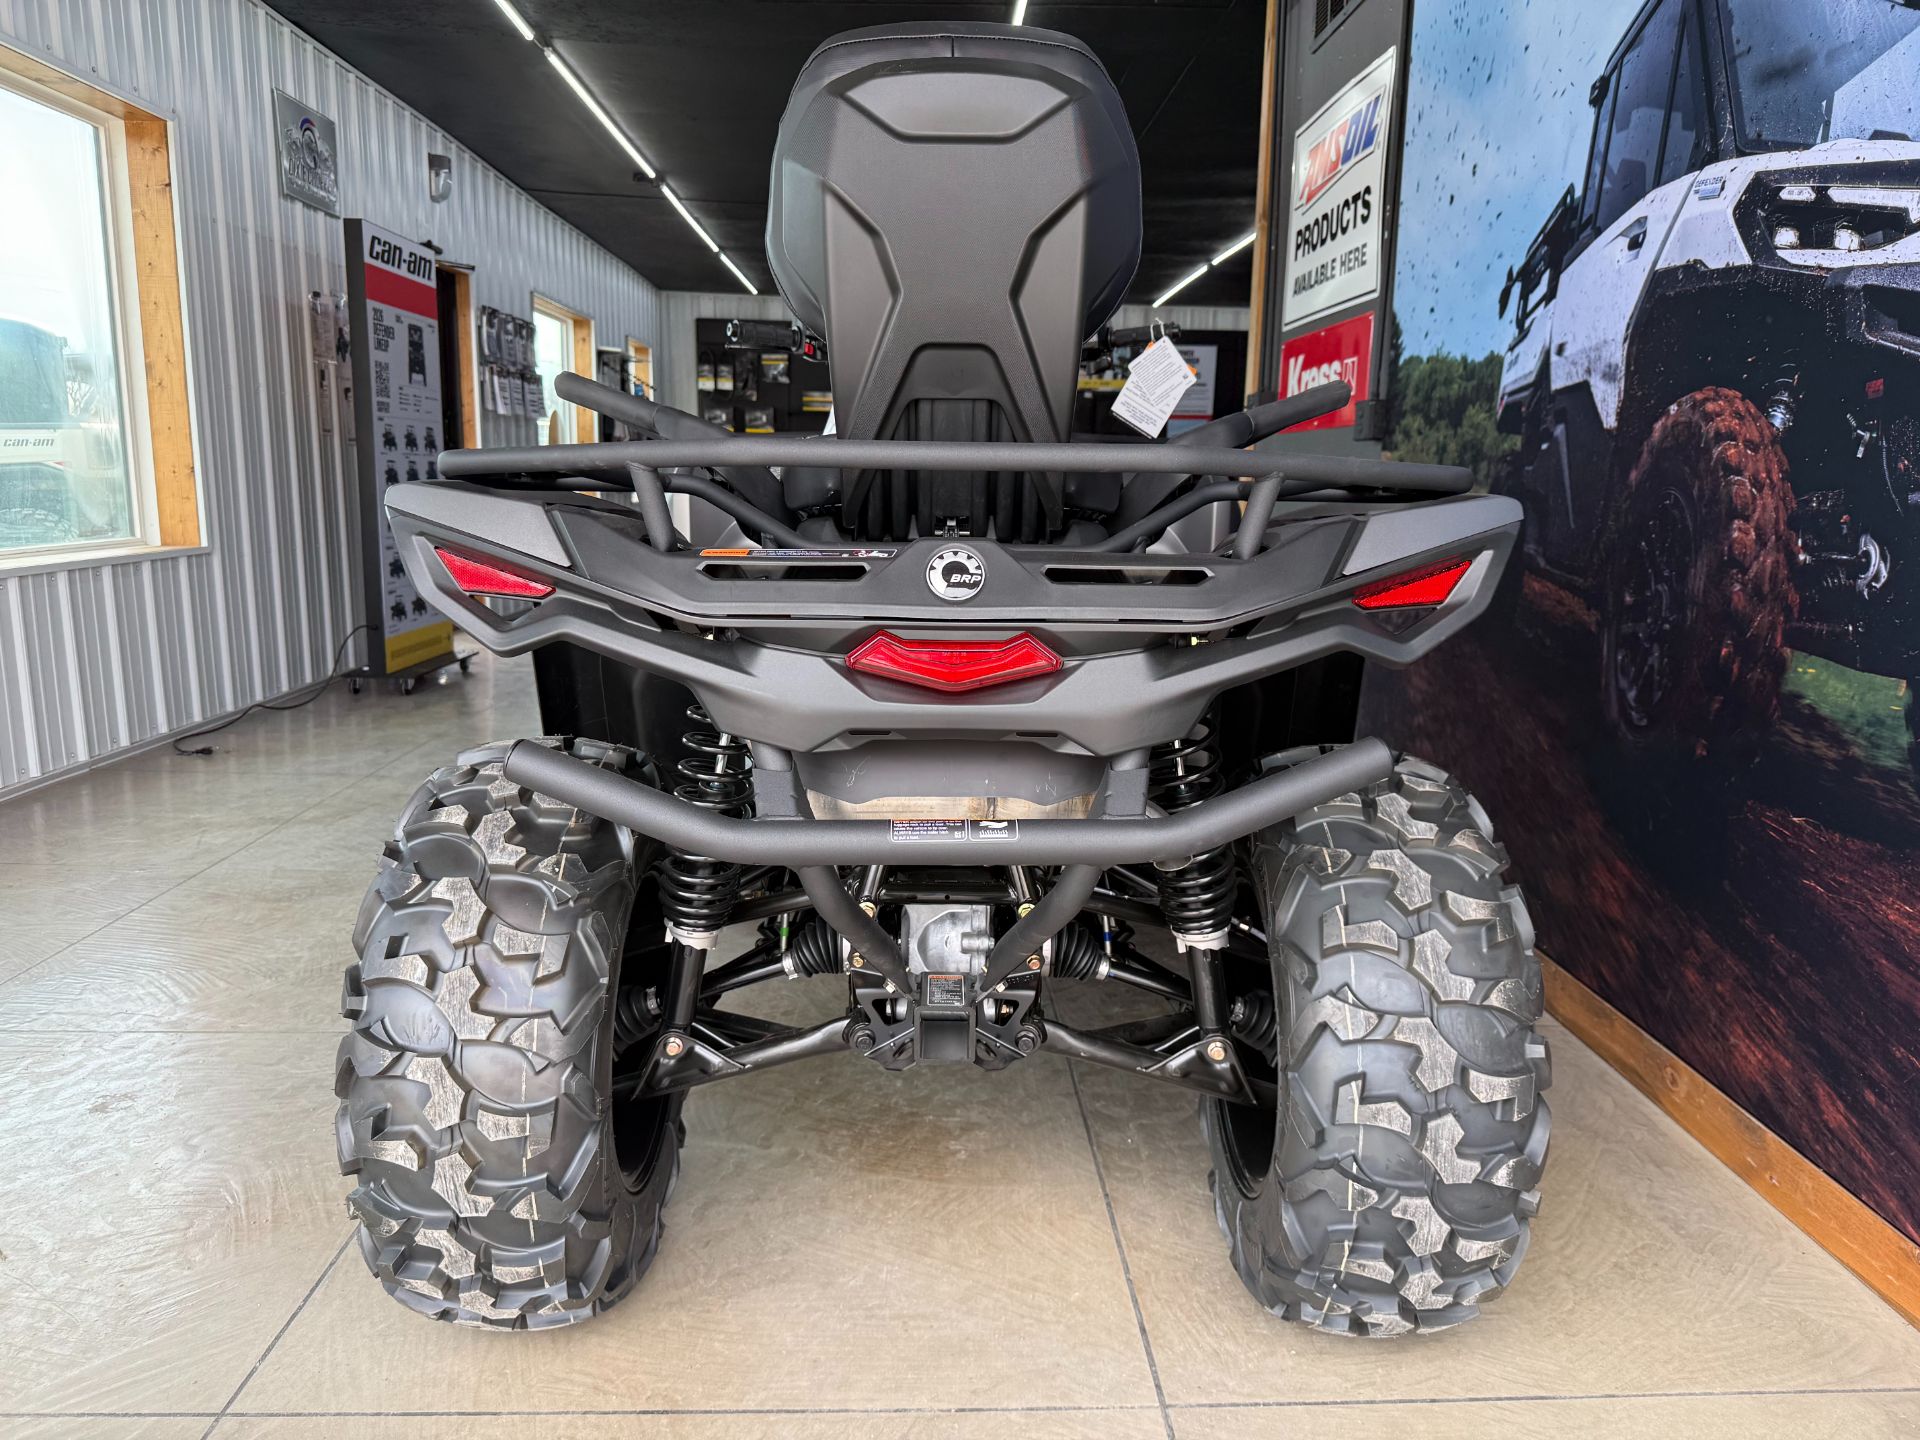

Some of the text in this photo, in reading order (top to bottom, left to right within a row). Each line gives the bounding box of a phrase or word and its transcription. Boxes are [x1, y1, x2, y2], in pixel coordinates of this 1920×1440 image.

[1299, 94, 1382, 205] AMSOIL
[1294, 185, 1372, 262] PRODUCTS
[369, 234, 432, 281] can-am
[1292, 242, 1368, 298] AVAILABLE HERE
[3, 438, 55, 447] can-am
[950, 573, 982, 584] BRP
